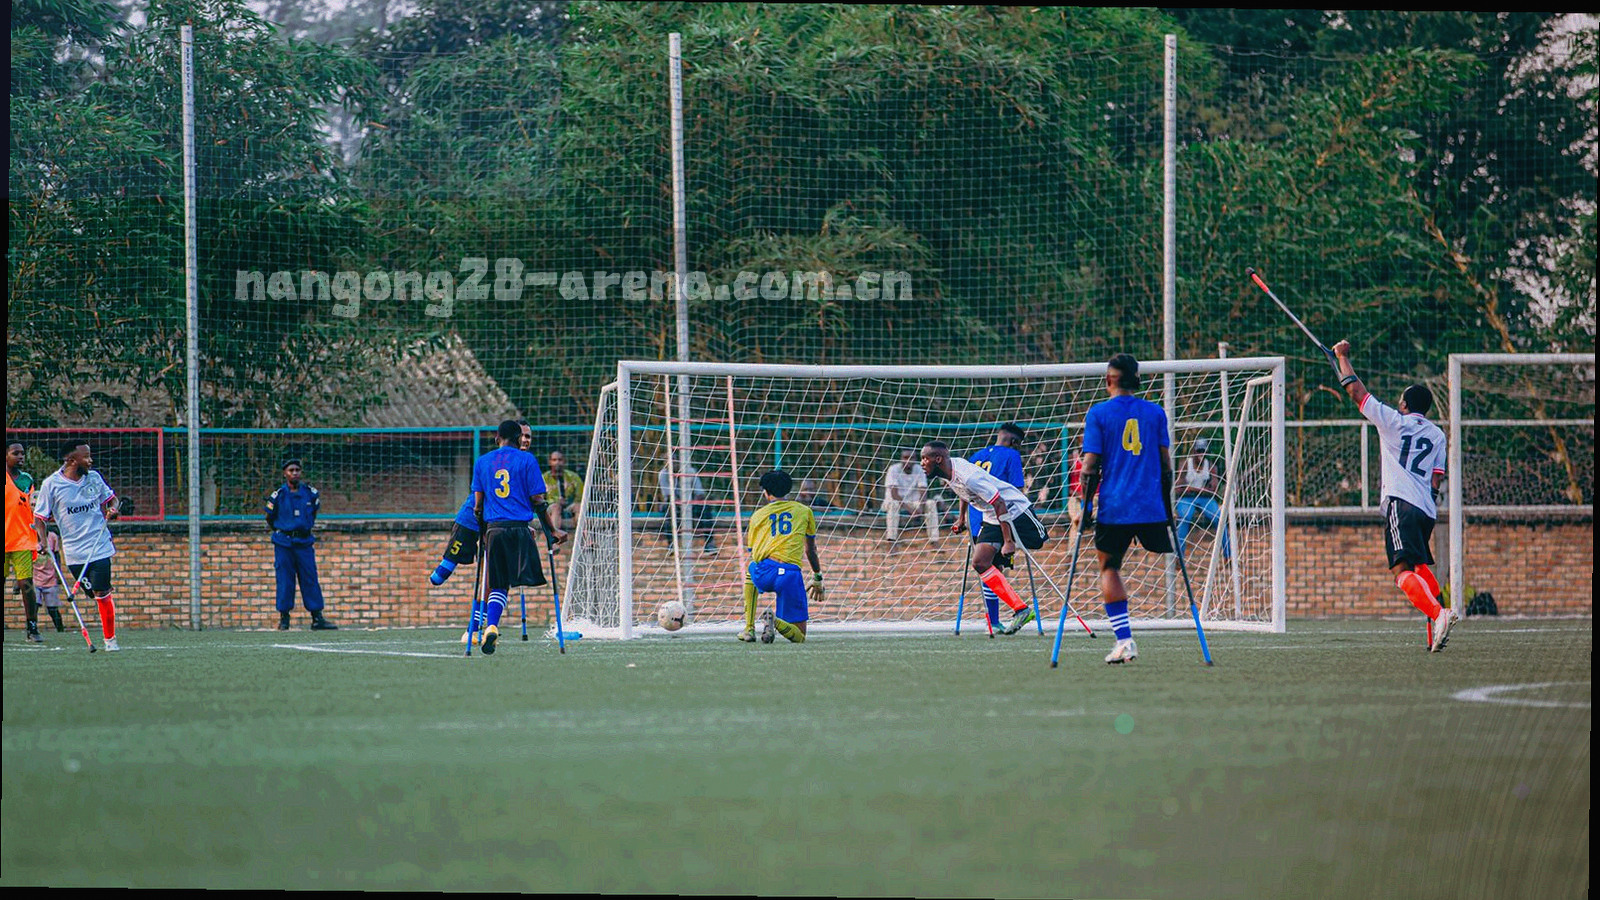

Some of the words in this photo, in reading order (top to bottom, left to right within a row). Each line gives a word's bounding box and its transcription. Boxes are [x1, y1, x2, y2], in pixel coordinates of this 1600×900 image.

[1122, 418, 1143, 456] 4
[1399, 435, 1434, 478] 12
[494, 468, 511, 499] 3
[769, 511, 793, 537] 16
[450, 540, 463, 555] 5
[81, 577, 92, 590] 8
